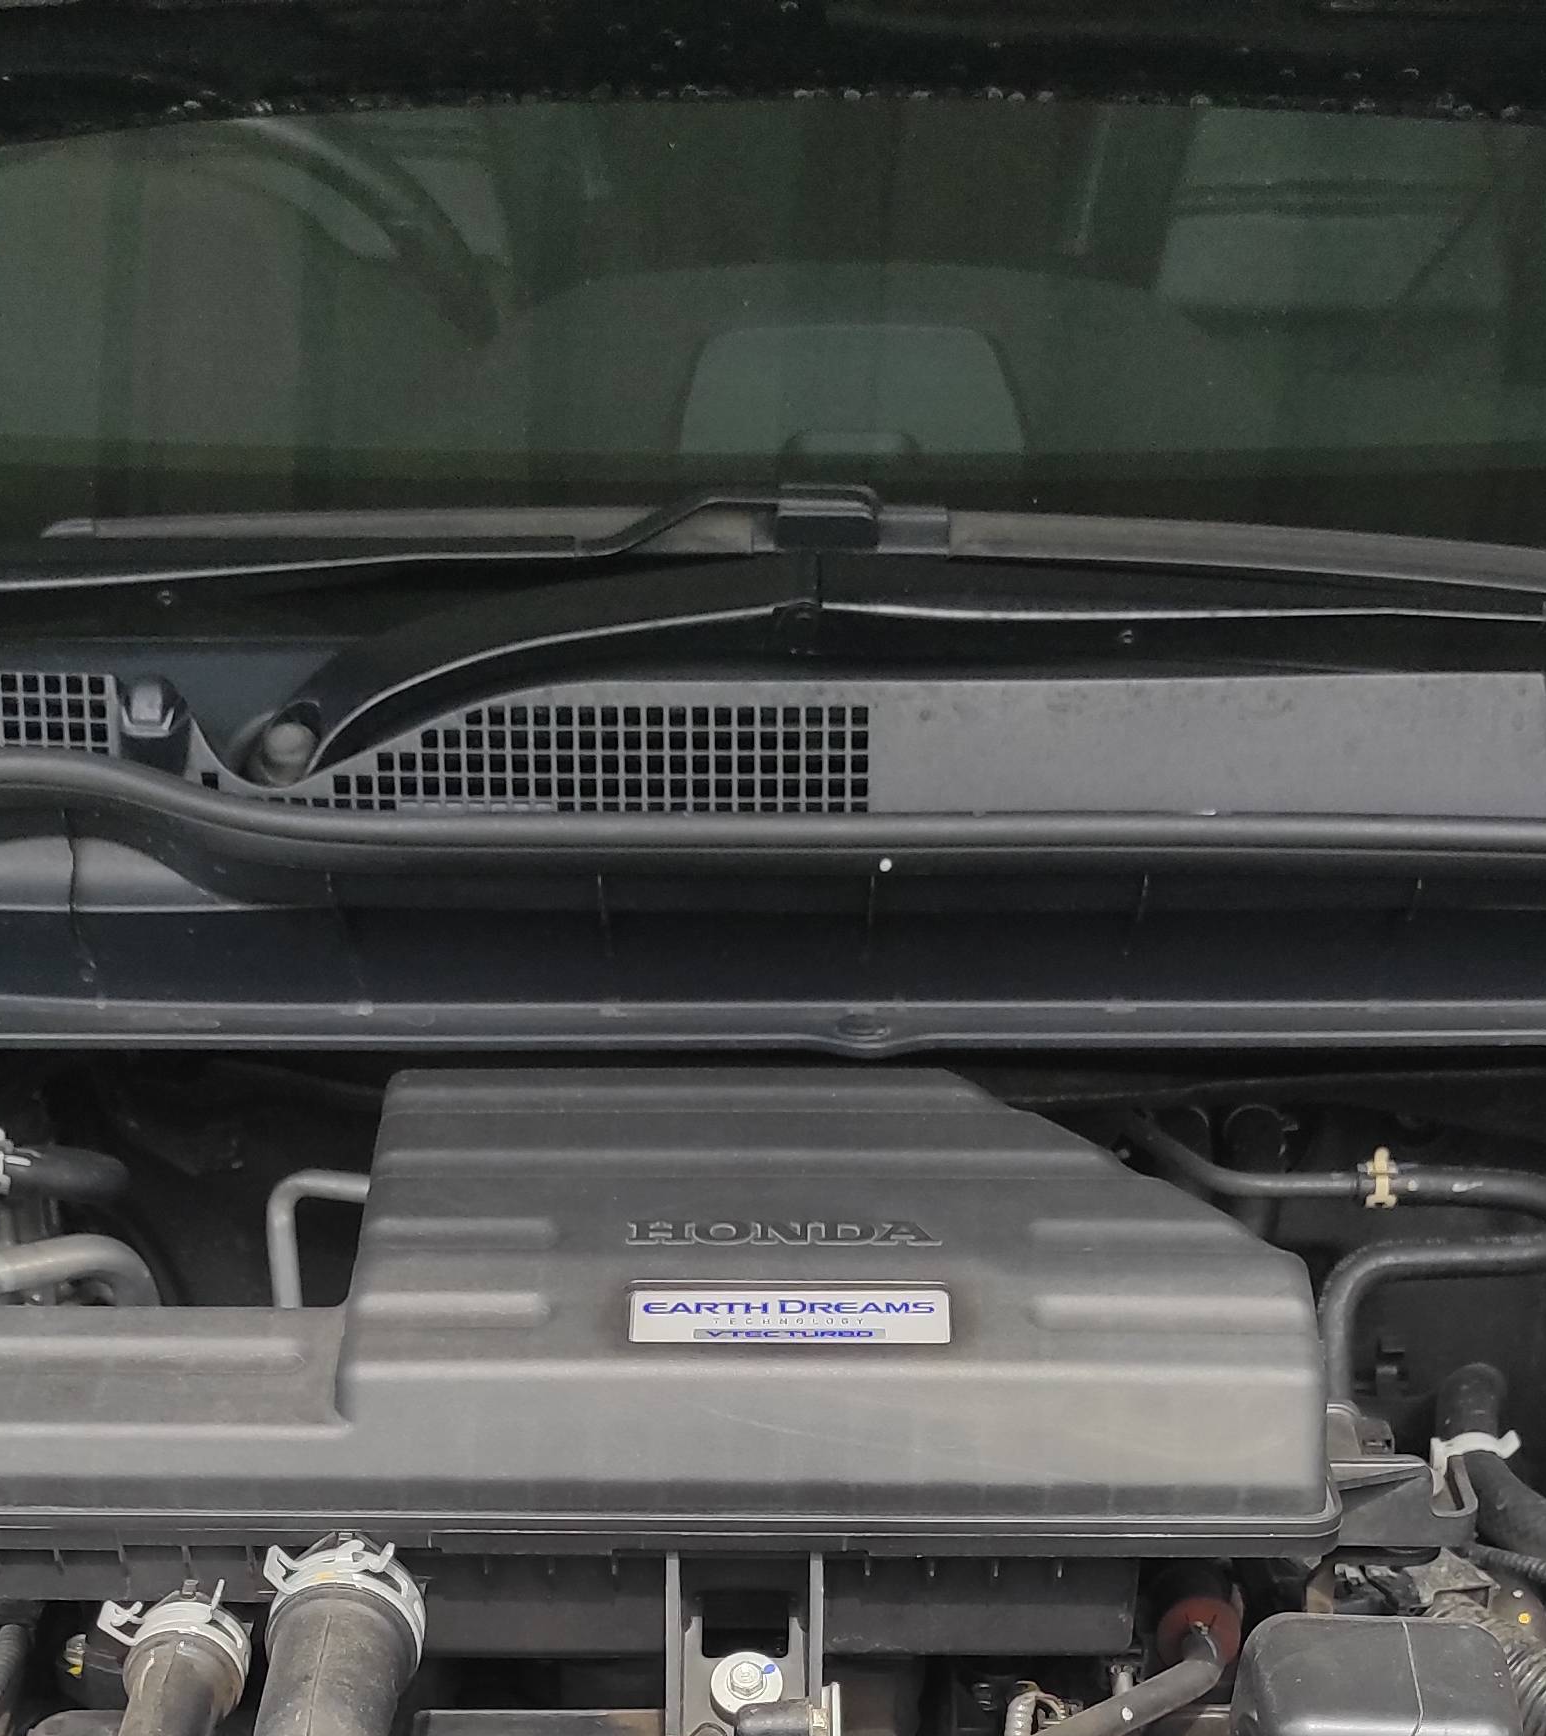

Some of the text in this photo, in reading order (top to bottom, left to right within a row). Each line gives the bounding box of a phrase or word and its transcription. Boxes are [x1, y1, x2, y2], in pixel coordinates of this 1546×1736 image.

[624, 1220, 943, 1247] HONDA
[642, 1299, 935, 1315] EARTH DREAMS
[712, 1317, 864, 1325] TECHNOLOGY
[706, 1330, 874, 1338] VTEC TURBO
